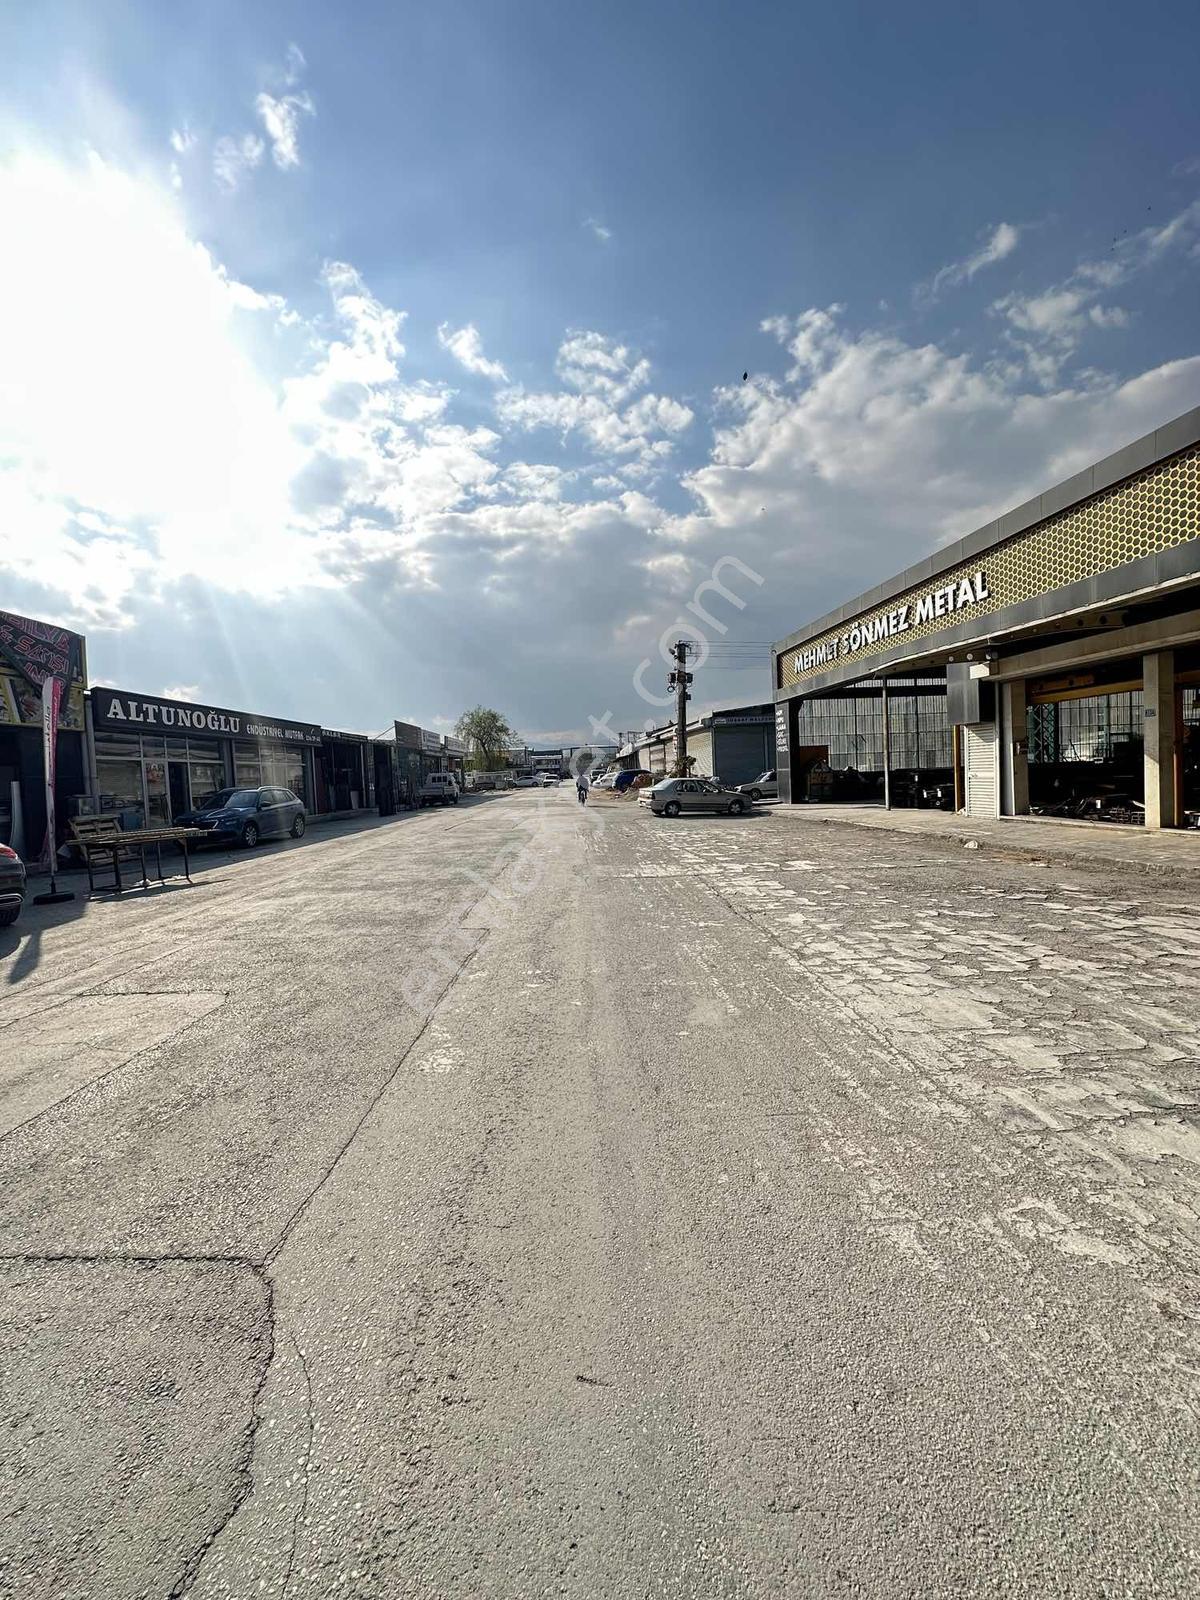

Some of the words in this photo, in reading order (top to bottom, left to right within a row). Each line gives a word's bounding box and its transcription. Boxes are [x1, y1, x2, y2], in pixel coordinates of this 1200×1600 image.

[793, 637, 839, 674] MEHMET
[842, 605, 911, 654] SÖNMEZ
[914, 572, 989, 625] METAL
[106, 698, 241, 734] ALTUNOĞLU
